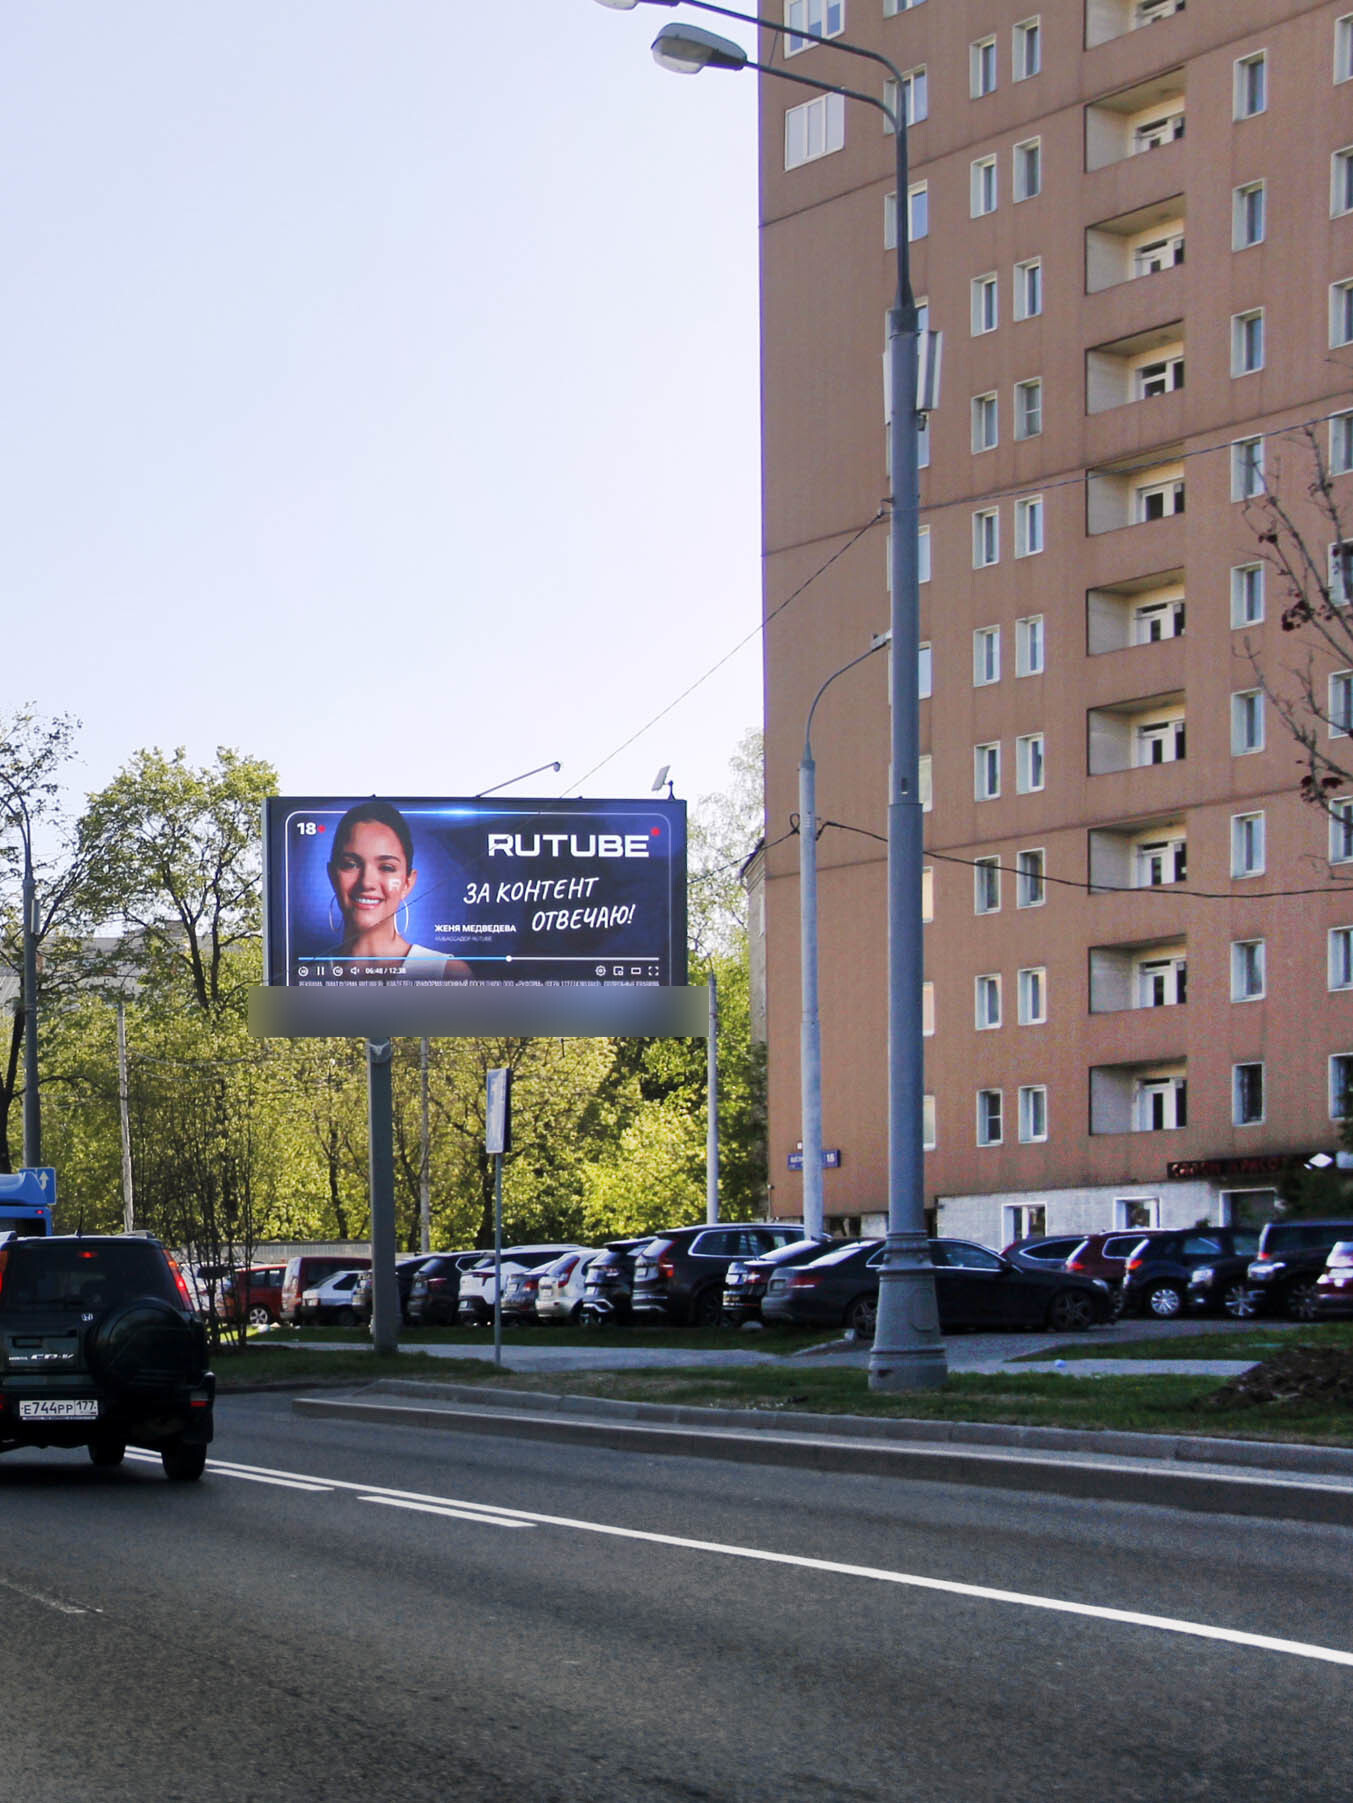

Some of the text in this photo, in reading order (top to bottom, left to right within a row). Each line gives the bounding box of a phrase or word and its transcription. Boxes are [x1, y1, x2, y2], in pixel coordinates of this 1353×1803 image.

[488, 834, 649, 858] RUTUBE
[463, 877, 599, 905] ЗА КОНТЕНТ
[434, 924, 517, 934] ЖЕНЯ МЕДВЕДЕВА
[531, 903, 636, 932] ОТВЕЧАЮ!
[76, 1400, 95, 1411] 177
